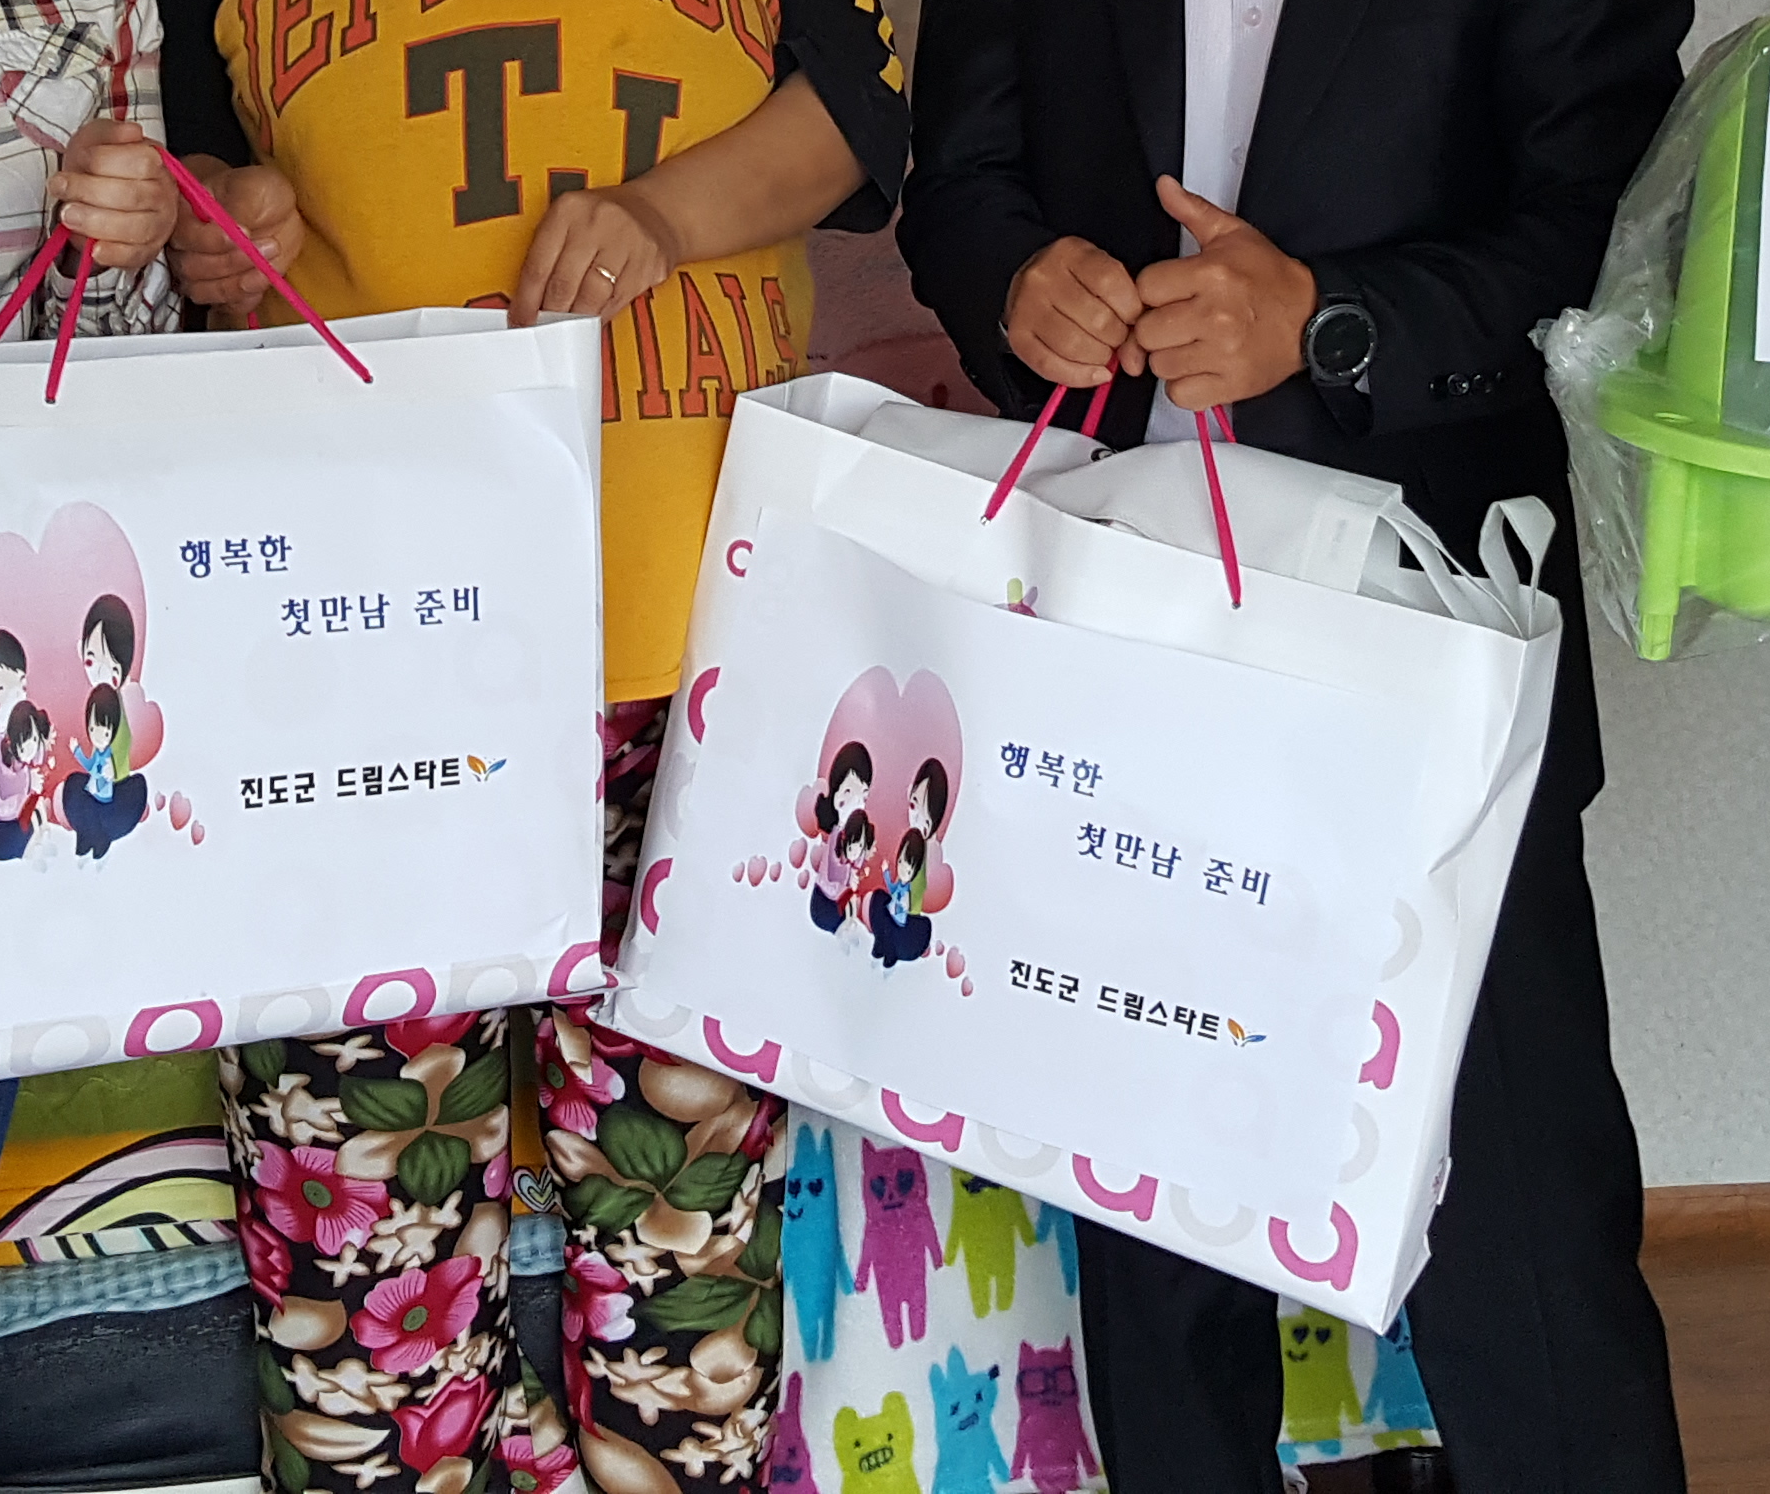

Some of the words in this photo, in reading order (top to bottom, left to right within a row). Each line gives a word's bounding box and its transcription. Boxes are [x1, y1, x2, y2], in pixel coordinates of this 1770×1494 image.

[179, 534, 293, 579] 행복한
[280, 592, 391, 637] 첫만남
[414, 585, 480, 626] 준비
[240, 771, 316, 810] 진도군
[336, 757, 461, 798] 드림스타트
[1000, 741, 1103, 798] 행복한
[1076, 821, 1182, 880] 첫만남
[1202, 858, 1272, 906] 준비
[1009, 959, 1080, 1004] 진도군
[1096, 985, 1220, 1041] 드림스타트
